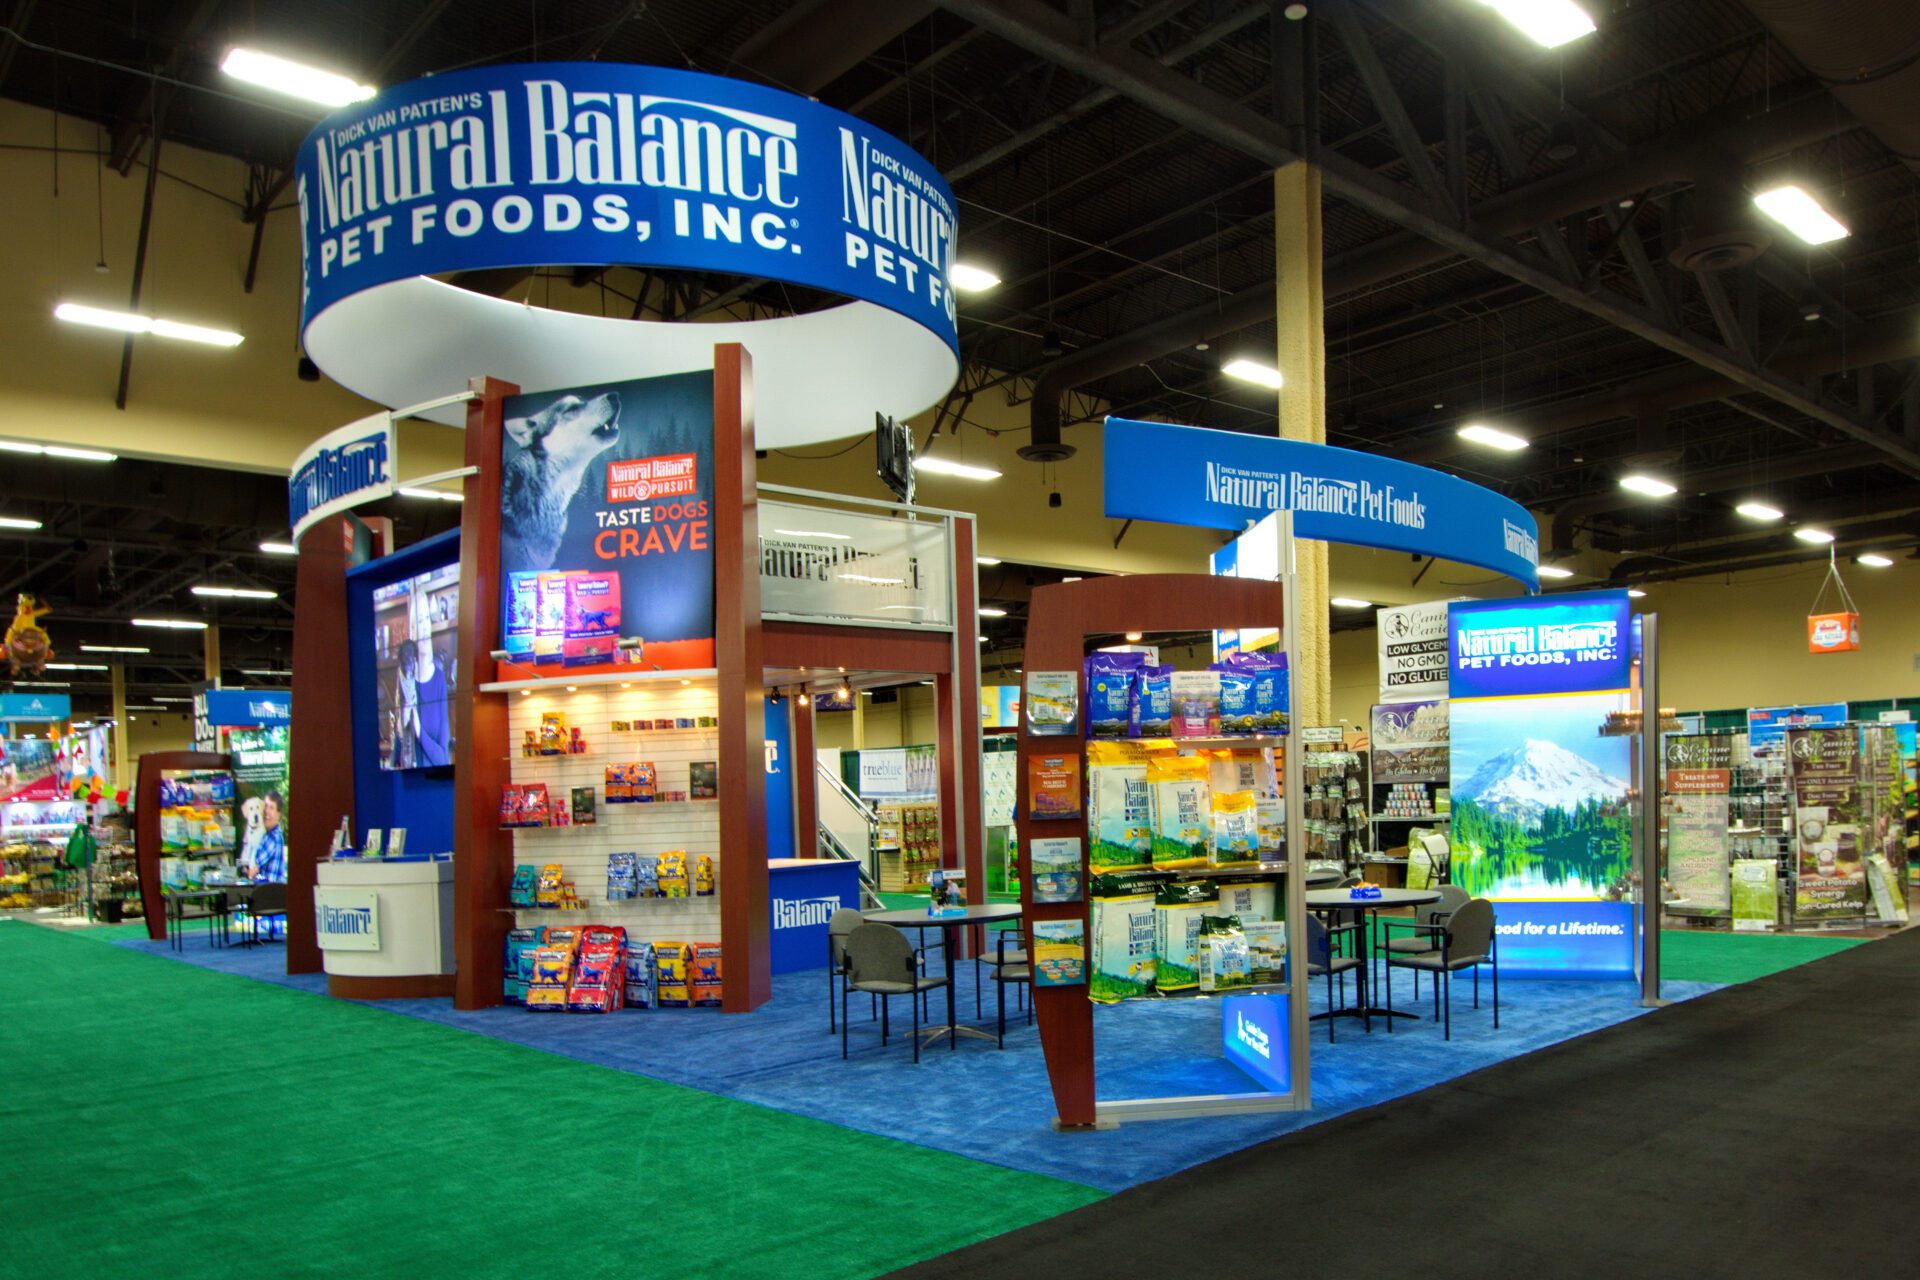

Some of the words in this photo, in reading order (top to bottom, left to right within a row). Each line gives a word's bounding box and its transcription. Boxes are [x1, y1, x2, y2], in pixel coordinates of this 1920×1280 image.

[338, 122, 365, 147] DICK
[367, 107, 396, 133] VAN
[401, 92, 483, 123] PATTEN'S
[316, 90, 514, 234] Natural
[524, 80, 799, 208] Balance
[872, 149, 900, 176] DICK
[902, 165, 922, 191] VAN
[321, 215, 392, 278] PET
[412, 194, 651, 245] FOODS,
[674, 199, 802, 255] INC.
[845, 232, 918, 294] PET
[611, 462, 651, 483] Natural
[652, 458, 693, 478] Balance
[1221, 466, 1236, 475] DICK
[1238, 468, 1250, 477] VAN
[1251, 471, 1279, 480] PATTEN'S
[611, 486, 634, 499] WILD
[651, 479, 693, 495] PURSUIT
[1206, 461, 1286, 510] Natural
[1290, 472, 1358, 517] Balance
[1360, 480, 1384, 522] Pet
[1386, 485, 1425, 530] Foods
[595, 507, 651, 528] TASTE
[653, 500, 708, 522] DOGS
[594, 520, 708, 560] CRAVE
[764, 539, 781, 548] DICK
[782, 541, 797, 549] VAN
[798, 543, 829, 552] PATTEN'S
[1388, 645, 1410, 656] LOW
[1457, 626, 1534, 657] Natural
[1538, 620, 1618, 651] Balance
[1398, 657, 1415, 668] NO
[1418, 653, 1446, 666] GMO
[1459, 656, 1495, 669] PET
[1500, 651, 1571, 667] FOODS,
[1576, 648, 1618, 662] INC.
[1390, 673, 1407, 684] NO
[863, 760, 902, 776] trueblue
[323, 904, 371, 935] Balance
[1523, 921, 1544, 936] for
[1547, 923, 1557, 935] a
